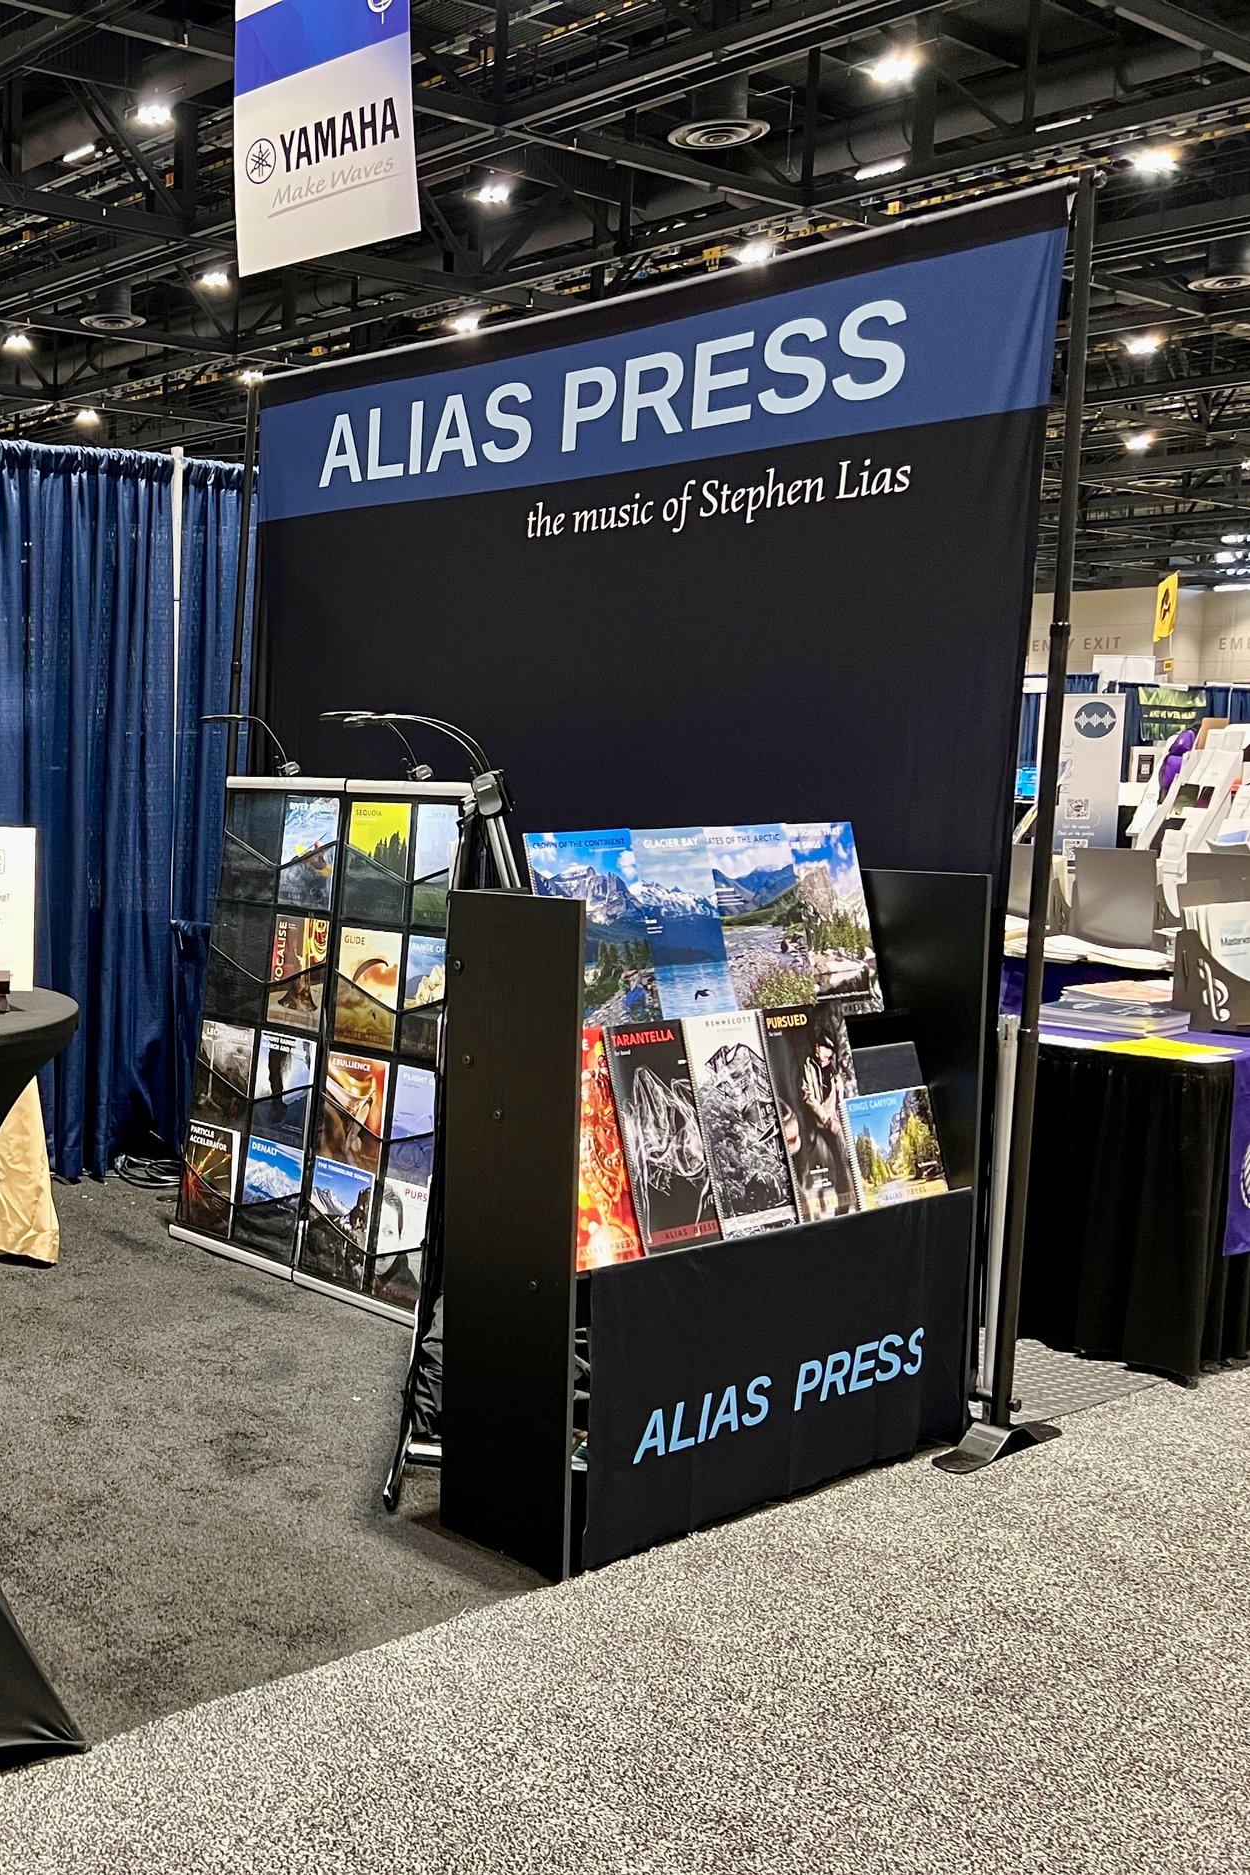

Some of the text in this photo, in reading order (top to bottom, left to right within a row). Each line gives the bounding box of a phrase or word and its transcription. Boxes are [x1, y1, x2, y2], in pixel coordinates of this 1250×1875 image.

[279, 96, 400, 173] YAMAHA
[271, 157, 394, 208] Make Waves
[317, 299, 908, 488] ALIAS PRESS
[526, 457, 912, 539] the music of Stephen Lias
[1083, 636, 1122, 651] EXIT
[355, 809, 383, 817] SEQUOIA
[532, 837, 625, 850] CROWN OF THE CONTINENT
[643, 836, 699, 849] GLACIER BAY
[725, 836, 736, 844] OF
[738, 835, 751, 843] THE
[753, 833, 781, 843] ARCTIC
[344, 934, 366, 945] GLIDE
[705, 1016, 752, 1028] KENNECOTT
[766, 1013, 808, 1030] PURSUED
[611, 1028, 675, 1047] TARANTELLA
[332, 1057, 371, 1073] EBULLIENCE
[403, 1072, 427, 1084] FLIGHT
[848, 1097, 897, 1112] KINGS CANYON
[190, 1124, 215, 1139] PARTICLE
[189, 1134, 228, 1152] ACCELERATOR
[251, 1141, 278, 1156] DENALI
[664, 1228, 689, 1240] ALIAS
[610, 1239, 635, 1250] PRESS
[632, 1326, 925, 1465] ALIAS PRESS
